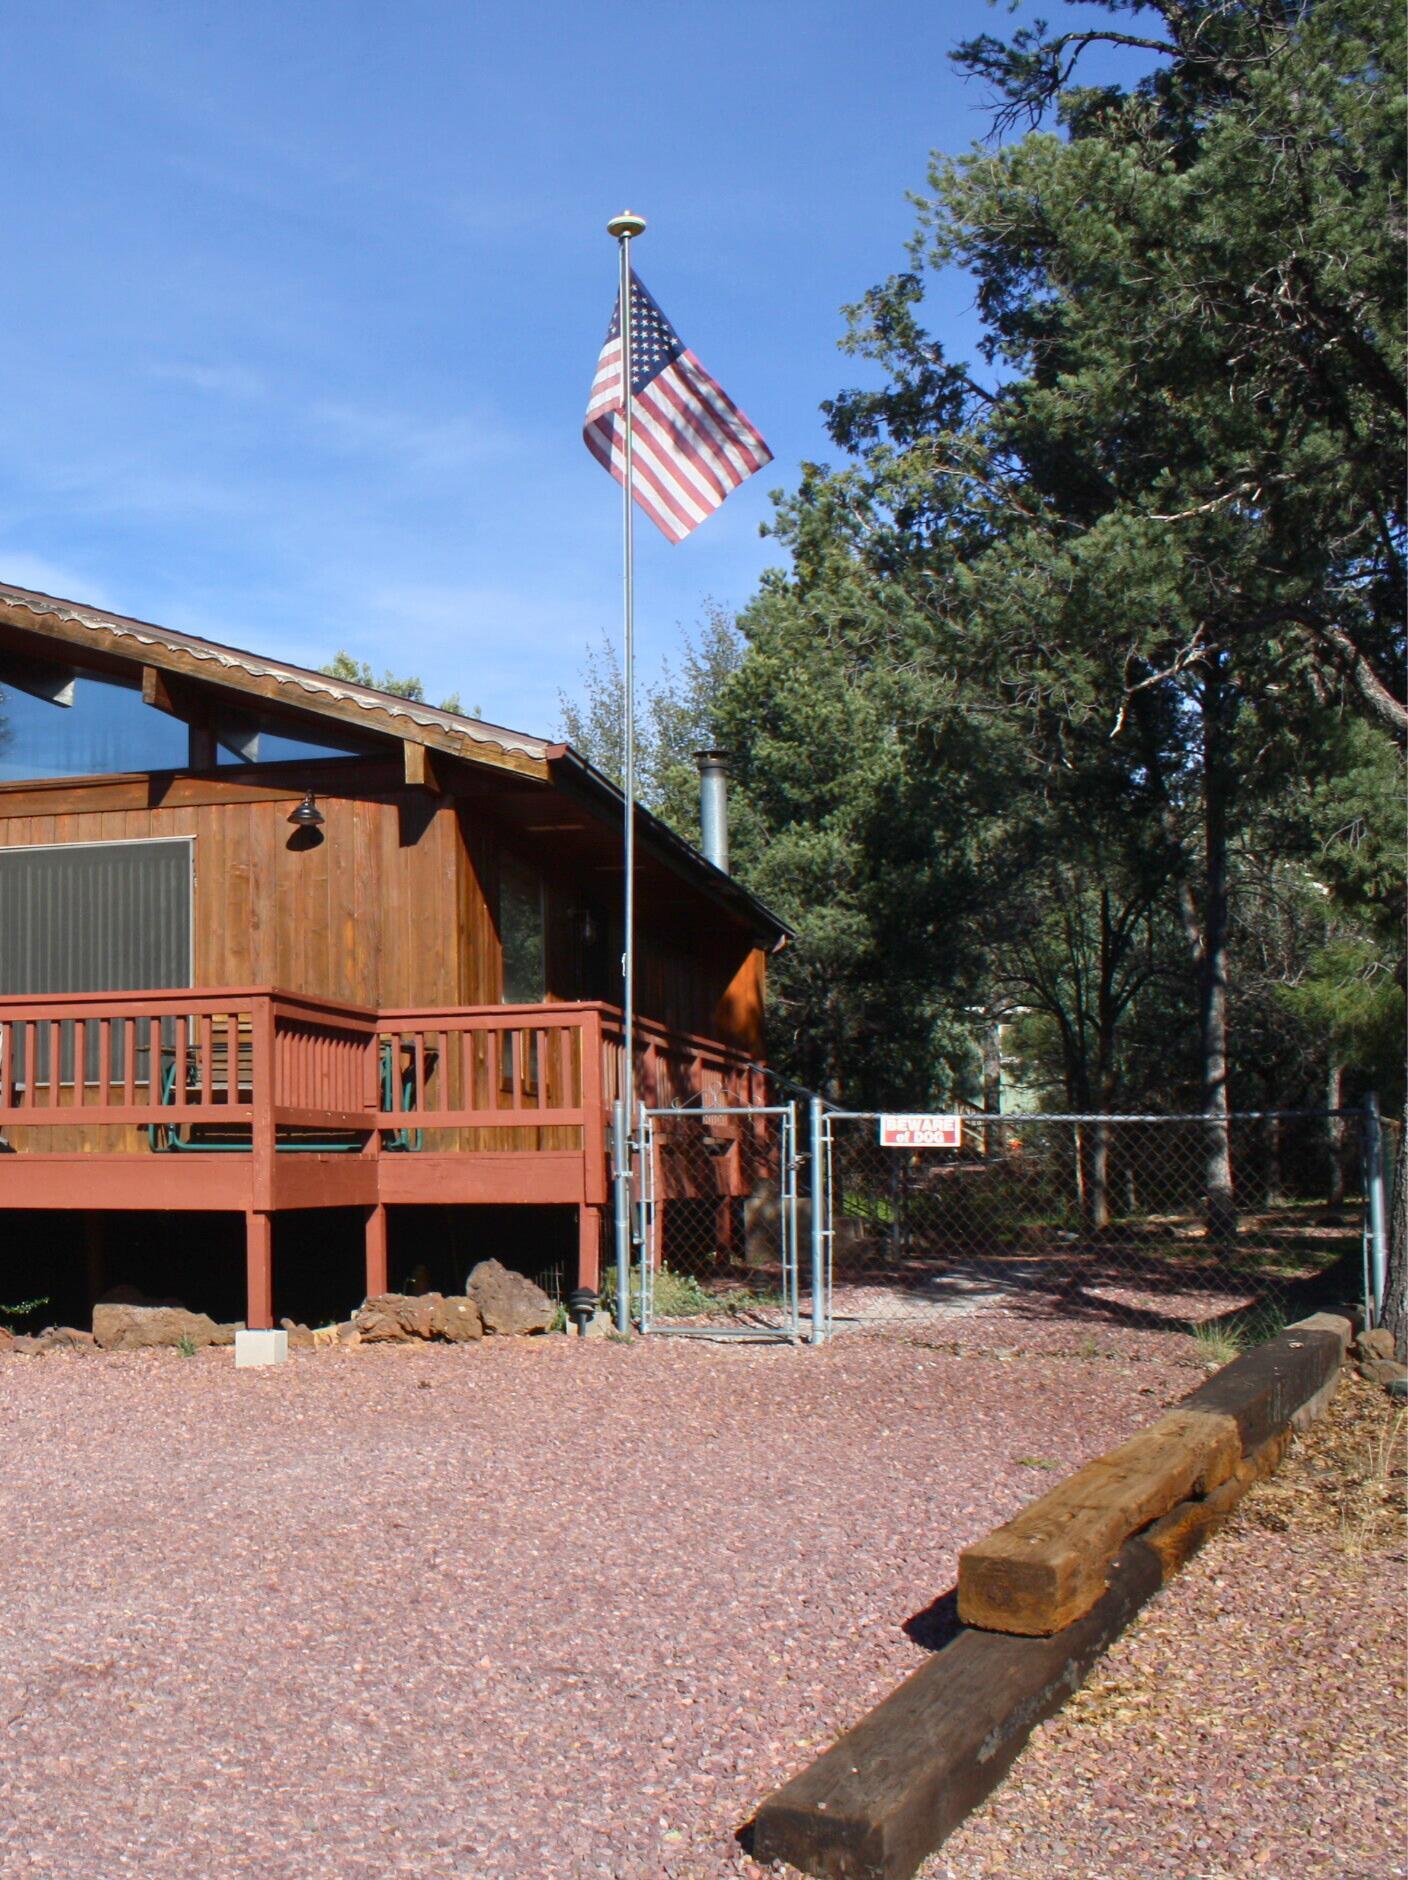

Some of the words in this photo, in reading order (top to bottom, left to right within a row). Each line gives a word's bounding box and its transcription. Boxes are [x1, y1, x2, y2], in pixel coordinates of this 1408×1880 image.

[886, 1119, 955, 1131] BEWARE
[896, 1131, 911, 1143] of
[913, 1131, 945, 1143] DOG
